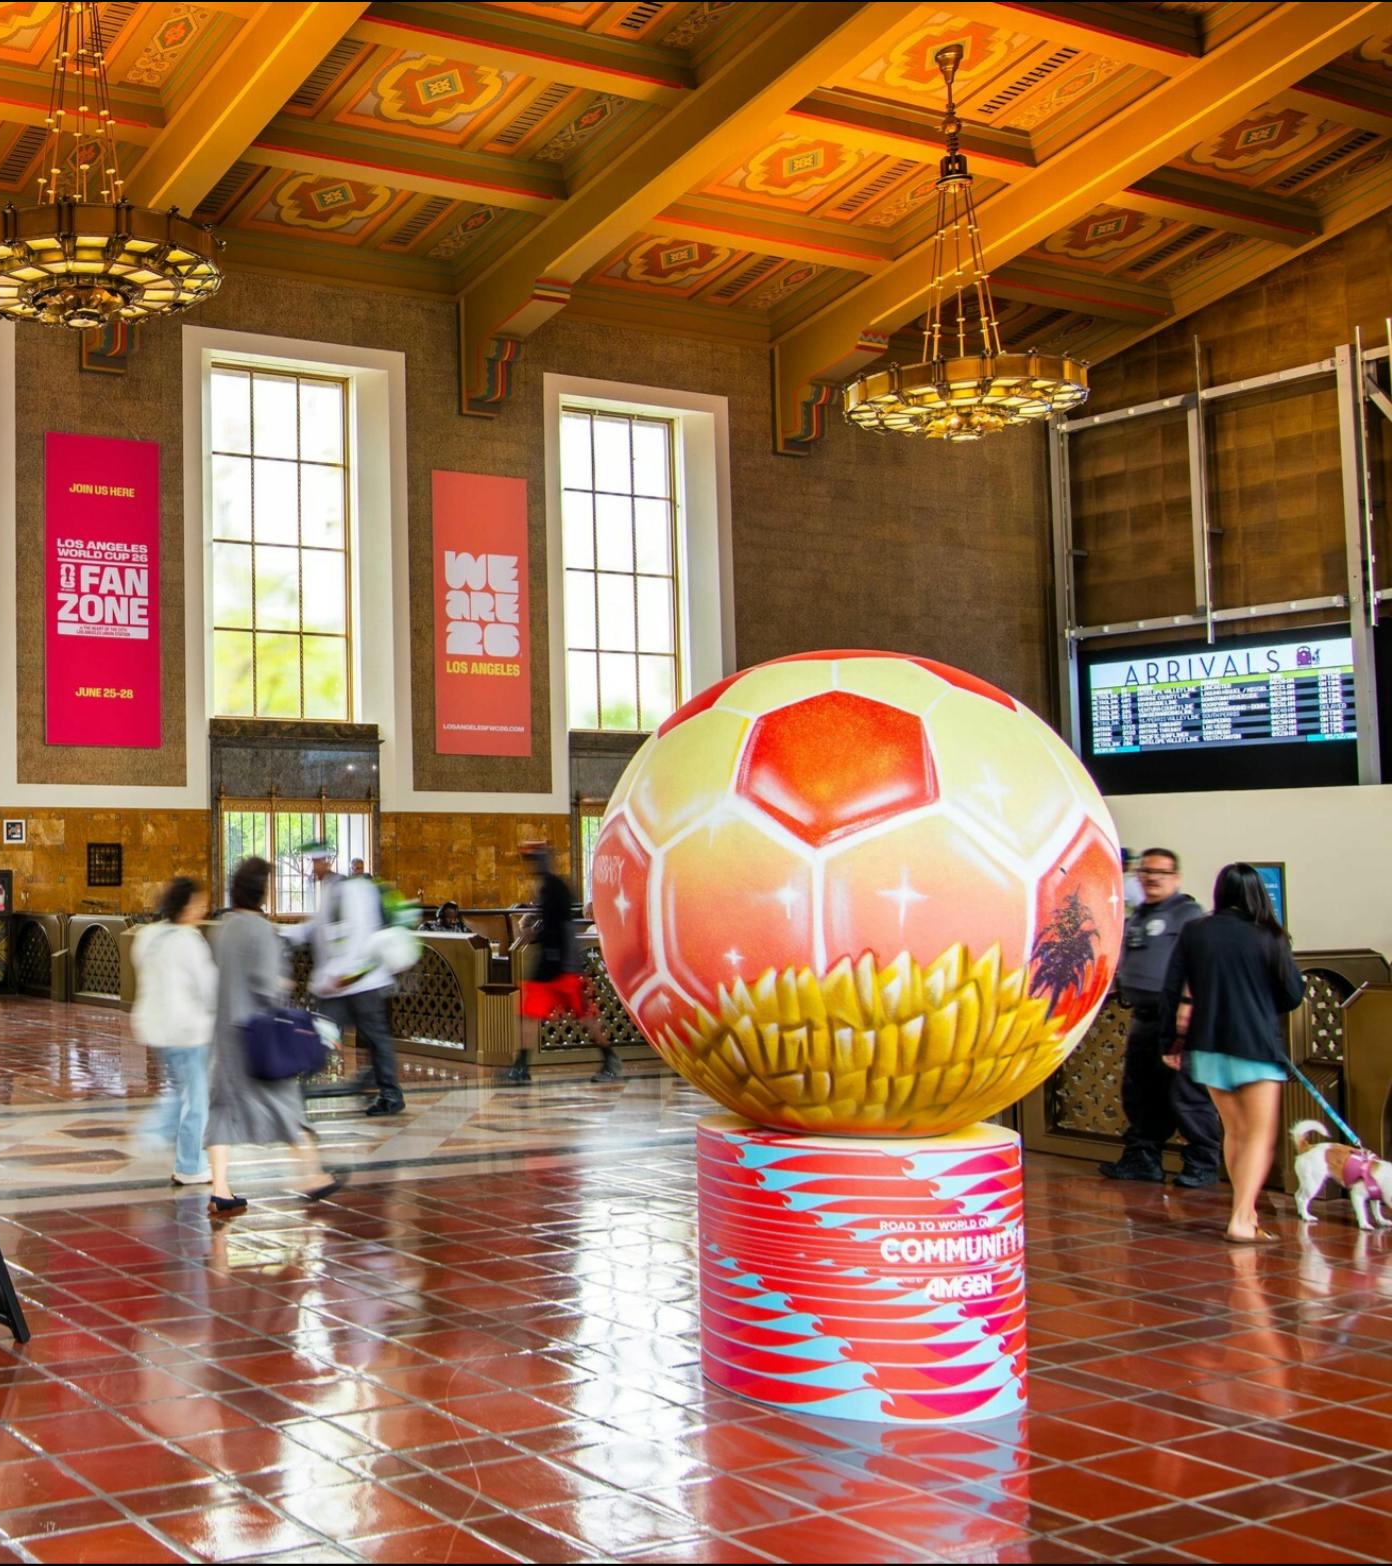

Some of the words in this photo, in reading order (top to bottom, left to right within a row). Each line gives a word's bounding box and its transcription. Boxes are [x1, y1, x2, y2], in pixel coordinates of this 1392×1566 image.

[69, 483, 93, 494] JOIN
[95, 485, 108, 495] US
[110, 487, 135, 497] HERE
[57, 538, 84, 549] LOS
[86, 540, 148, 553] ANGELES
[58, 548, 102, 559] WORLD
[104, 551, 130, 561] CUP
[132, 553, 148, 562] 26
[80, 565, 148, 596] FAN
[444, 550, 519, 594] WE
[57, 592, 149, 625] ZONE
[446, 590, 519, 623] ARE
[446, 620, 520, 657] 26
[446, 661, 468, 673] LOS
[470, 662, 521, 676] ANGELES
[1125, 650, 1280, 686] ARRIVALS
[76, 687, 101, 698] JUNE
[103, 688, 134, 699] 25-28
[879, 1221, 916, 1232] ROAD
[918, 1221, 935, 1231] TO
[938, 1219, 976, 1231] WORLD
[880, 1228, 1016, 1263] COMMUNITY
[925, 1273, 992, 1298] AMGEN
